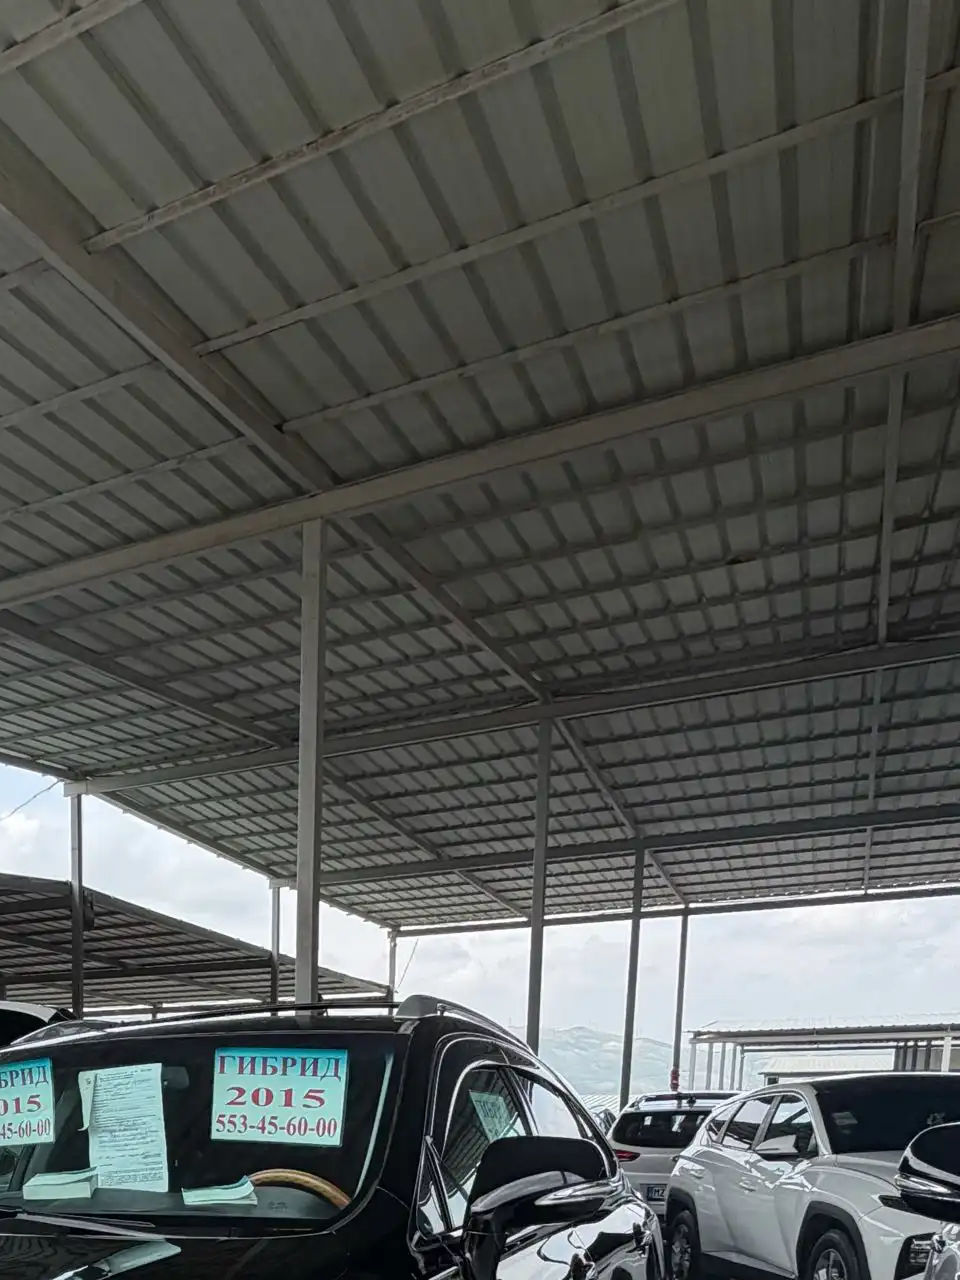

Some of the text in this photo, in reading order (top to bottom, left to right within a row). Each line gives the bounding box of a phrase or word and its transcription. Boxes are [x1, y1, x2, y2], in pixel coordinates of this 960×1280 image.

[218, 1055, 342, 1082] ГИБРИД
[225, 1086, 326, 1108] 2015
[215, 1114, 338, 1138] 553-45-60-00
